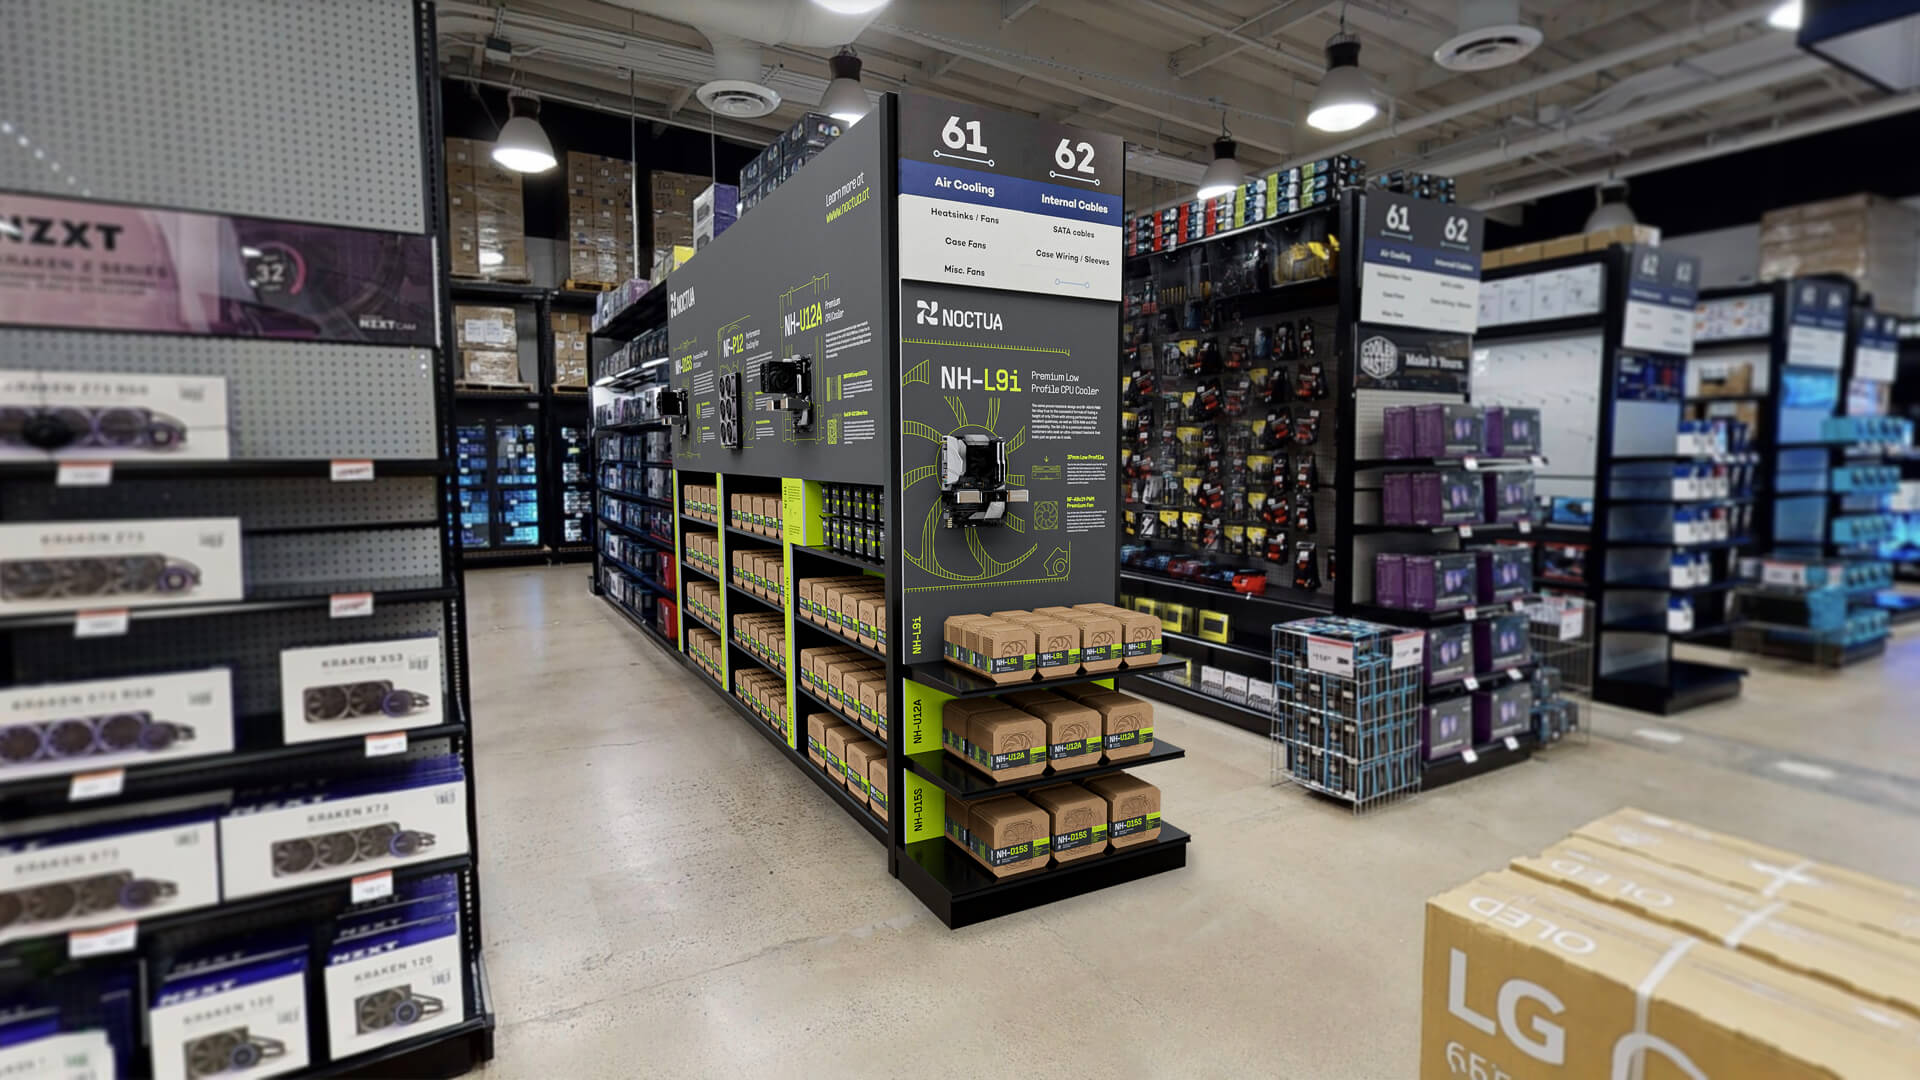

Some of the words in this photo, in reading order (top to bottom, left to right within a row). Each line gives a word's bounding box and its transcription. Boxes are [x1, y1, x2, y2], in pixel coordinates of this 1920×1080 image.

[941, 115, 988, 154] 61
[1054, 138, 1095, 174] 62
[825, 188, 841, 207] Learn
[842, 178, 857, 197] more
[934, 176, 952, 188] Air
[953, 179, 995, 198] Cooling
[826, 186, 870, 224] www.noctua.at
[1041, 193, 1077, 209] Internal
[1078, 200, 1109, 214] Cables
[930, 207, 974, 222] Heatsinks
[980, 214, 1000, 225] Fans
[1386, 203, 1411, 232] 61
[1053, 225, 1071, 236] SATA
[1072, 229, 1095, 239] cables
[1444, 216, 1469, 243] 62
[945, 237, 967, 247] Case
[968, 239, 987, 250] Fans
[1036, 249, 1054, 259] Case
[1055, 252, 1079, 264] Wiring
[1084, 255, 1110, 266] Sleeves
[256, 263, 284, 282] 32
[944, 264, 965, 275] Misc.
[966, 267, 986, 277] Fans
[676, 286, 696, 315] NOCTUA
[359, 319, 395, 331] NZXT
[784, 301, 823, 337] NH-U12A
[942, 309, 1003, 331] NOCTUA
[723, 332, 744, 359] NF-P12
[1405, 352, 1430, 367] Make
[941, 365, 1022, 393] NH-L9i
[1031, 370, 1065, 381] Premium
[1065, 373, 1080, 382] Low
[1031, 383, 1060, 394] Profile
[1060, 385, 1075, 395] CPU
[1075, 386, 1100, 396] Cooler
[912, 615, 922, 655] NH-L9i
[913, 699, 922, 744] NH-U12A
[1054, 742, 1082, 753] NH-U12A
[1109, 732, 1135, 743] NH-U12A
[995, 752, 1025, 764] NH-U12A
[307, 808, 362, 823] KRAKEN
[914, 787, 923, 832] NH-D15S
[1114, 817, 1143, 831] NH-D15S
[1057, 830, 1088, 845] NH-D15S
[996, 844, 1029, 860] NH-D15S
[1467, 895, 1597, 954] OLED
[1448, 946, 1566, 1066] LG
